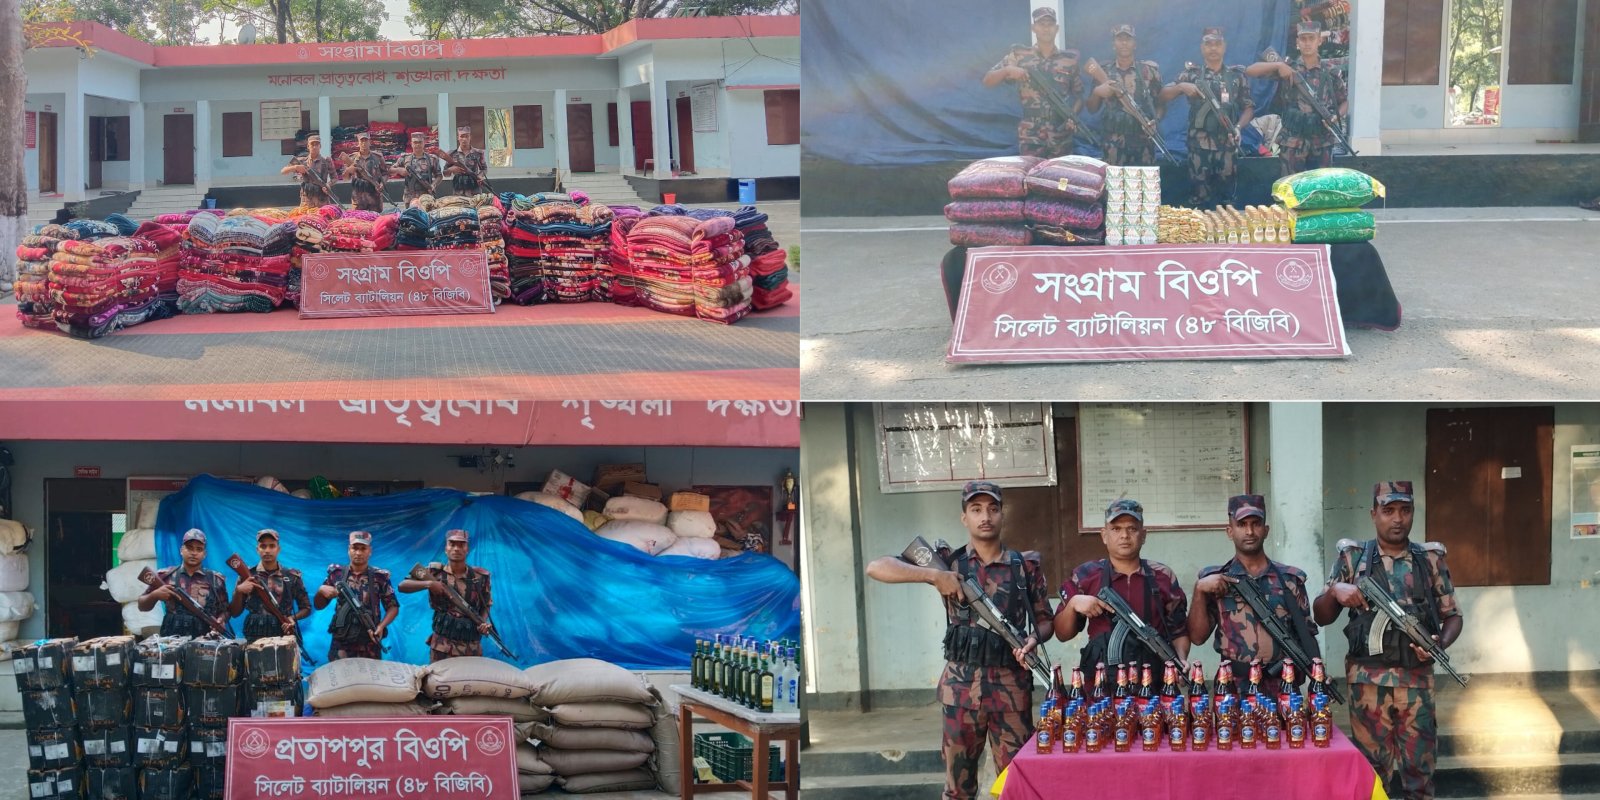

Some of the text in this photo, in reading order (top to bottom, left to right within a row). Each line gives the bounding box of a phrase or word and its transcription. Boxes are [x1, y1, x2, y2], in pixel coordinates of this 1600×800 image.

[318, 39, 445, 59] সংগ্রাম বিওপি
[456, 66, 507, 81] দক্ষতা
[336, 259, 452, 285] সংগ্রাম বিওপি
[1032, 258, 1262, 304] সংগ্রাম বিওপি
[320, 286, 471, 305] সিলেট ব্যাটালিয়ন (৪৮ বিজিবি)
[994, 308, 1300, 340] সিলেট ব্যাটালিয়ন (৪৮ বিজিবি)
[274, 728, 470, 769] প্রতাপপুর বিওপি
[254, 772, 493, 798] সিলেট ব্যাটালিয়ন (৪৮ বিজিবি)
